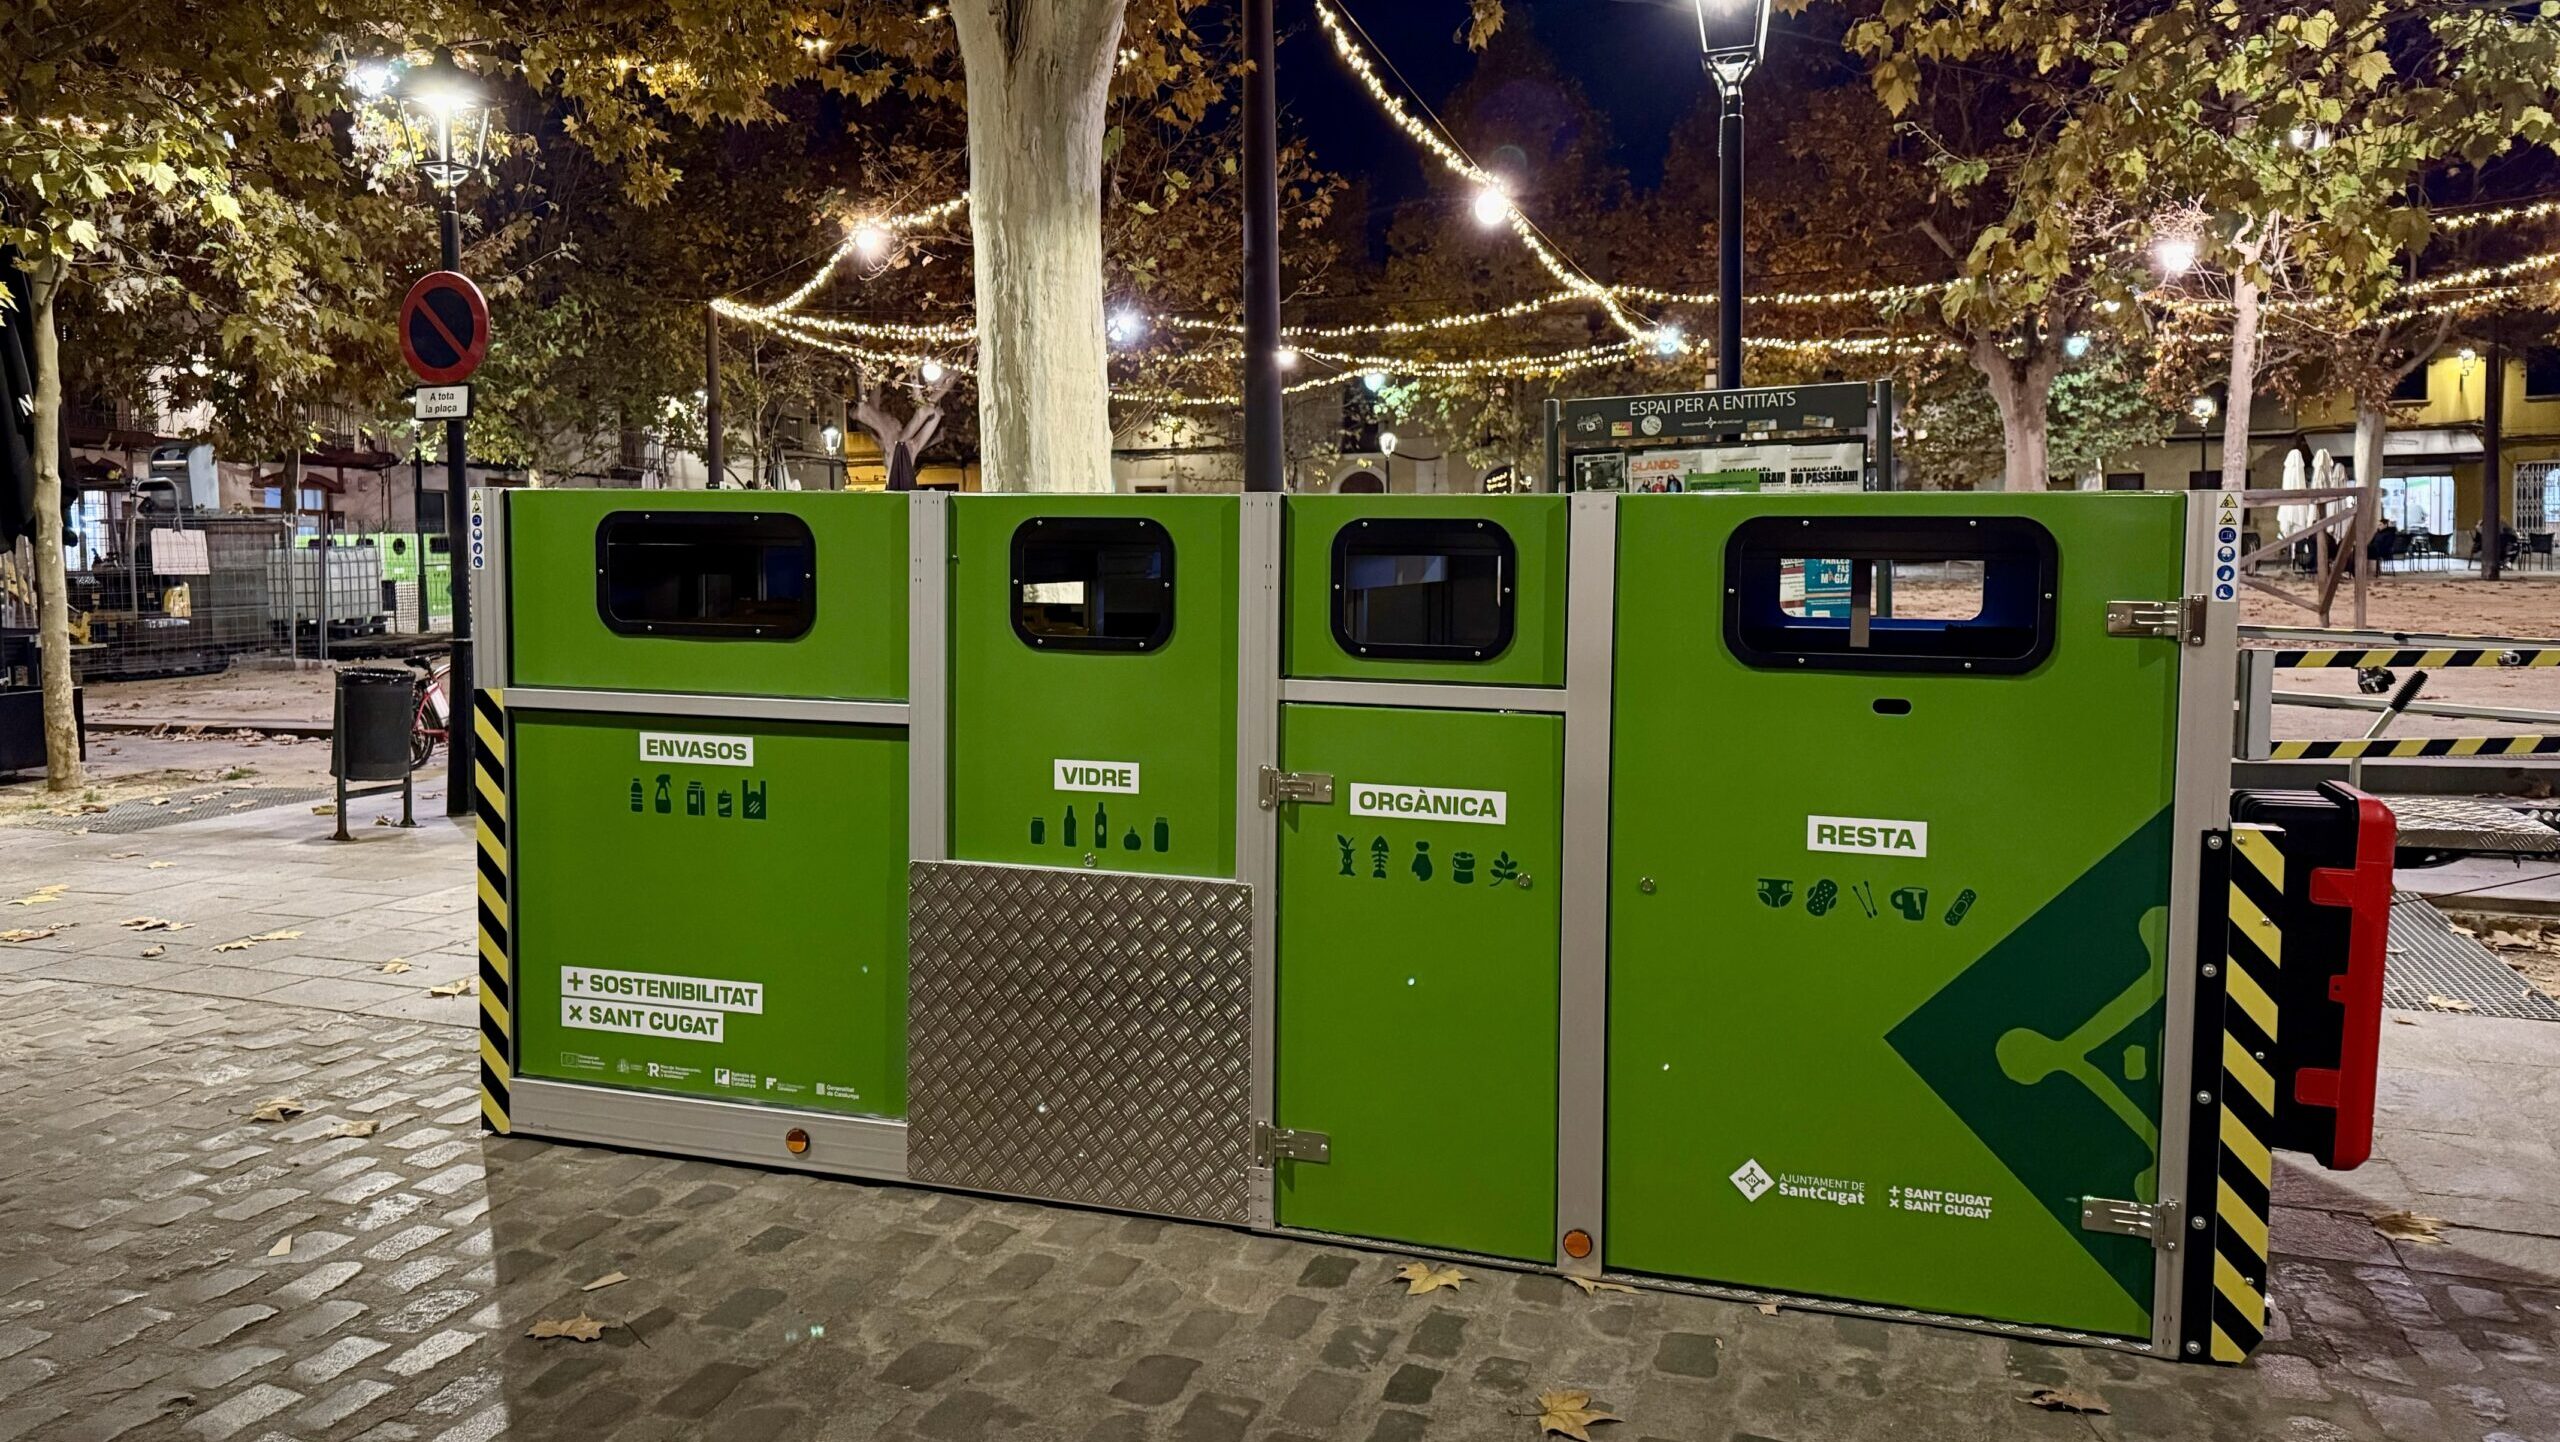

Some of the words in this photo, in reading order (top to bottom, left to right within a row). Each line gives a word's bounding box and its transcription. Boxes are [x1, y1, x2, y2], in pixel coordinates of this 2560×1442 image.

[430, 392, 436, 401] A
[438, 391, 455, 401] tota
[1629, 400, 1671, 416] ESPAI
[1674, 397, 1705, 414] PER
[1707, 397, 1720, 412] A
[1723, 391, 1797, 411] ENTITATS
[425, 404, 433, 413] la
[434, 403, 457, 415] plaça
[1791, 472, 1803, 484] NO
[1805, 470, 1858, 483] PASSARAN!
[1836, 564, 1850, 573] FAS
[646, 739, 747, 760] ENVASOS
[1062, 766, 1131, 787] VIDRE
[1358, 789, 1498, 818] ORGÀNICA
[1817, 824, 1916, 850] RESTA
[589, 974, 758, 1007] SOSTENIBILITAT
[589, 1006, 644, 1028] SANT
[649, 1011, 718, 1036] CUGAT
[1779, 1173, 1850, 1190] AJUNTAMENT
[1852, 1181, 1865, 1192] DE
[1778, 1183, 1865, 1206] SantCugat
[1904, 1187, 1942, 1201] SANT
[1944, 1192, 1992, 1207] CUGAT
[1904, 1200, 1942, 1214] SANT
[1944, 1205, 1992, 1219] CUGAT
